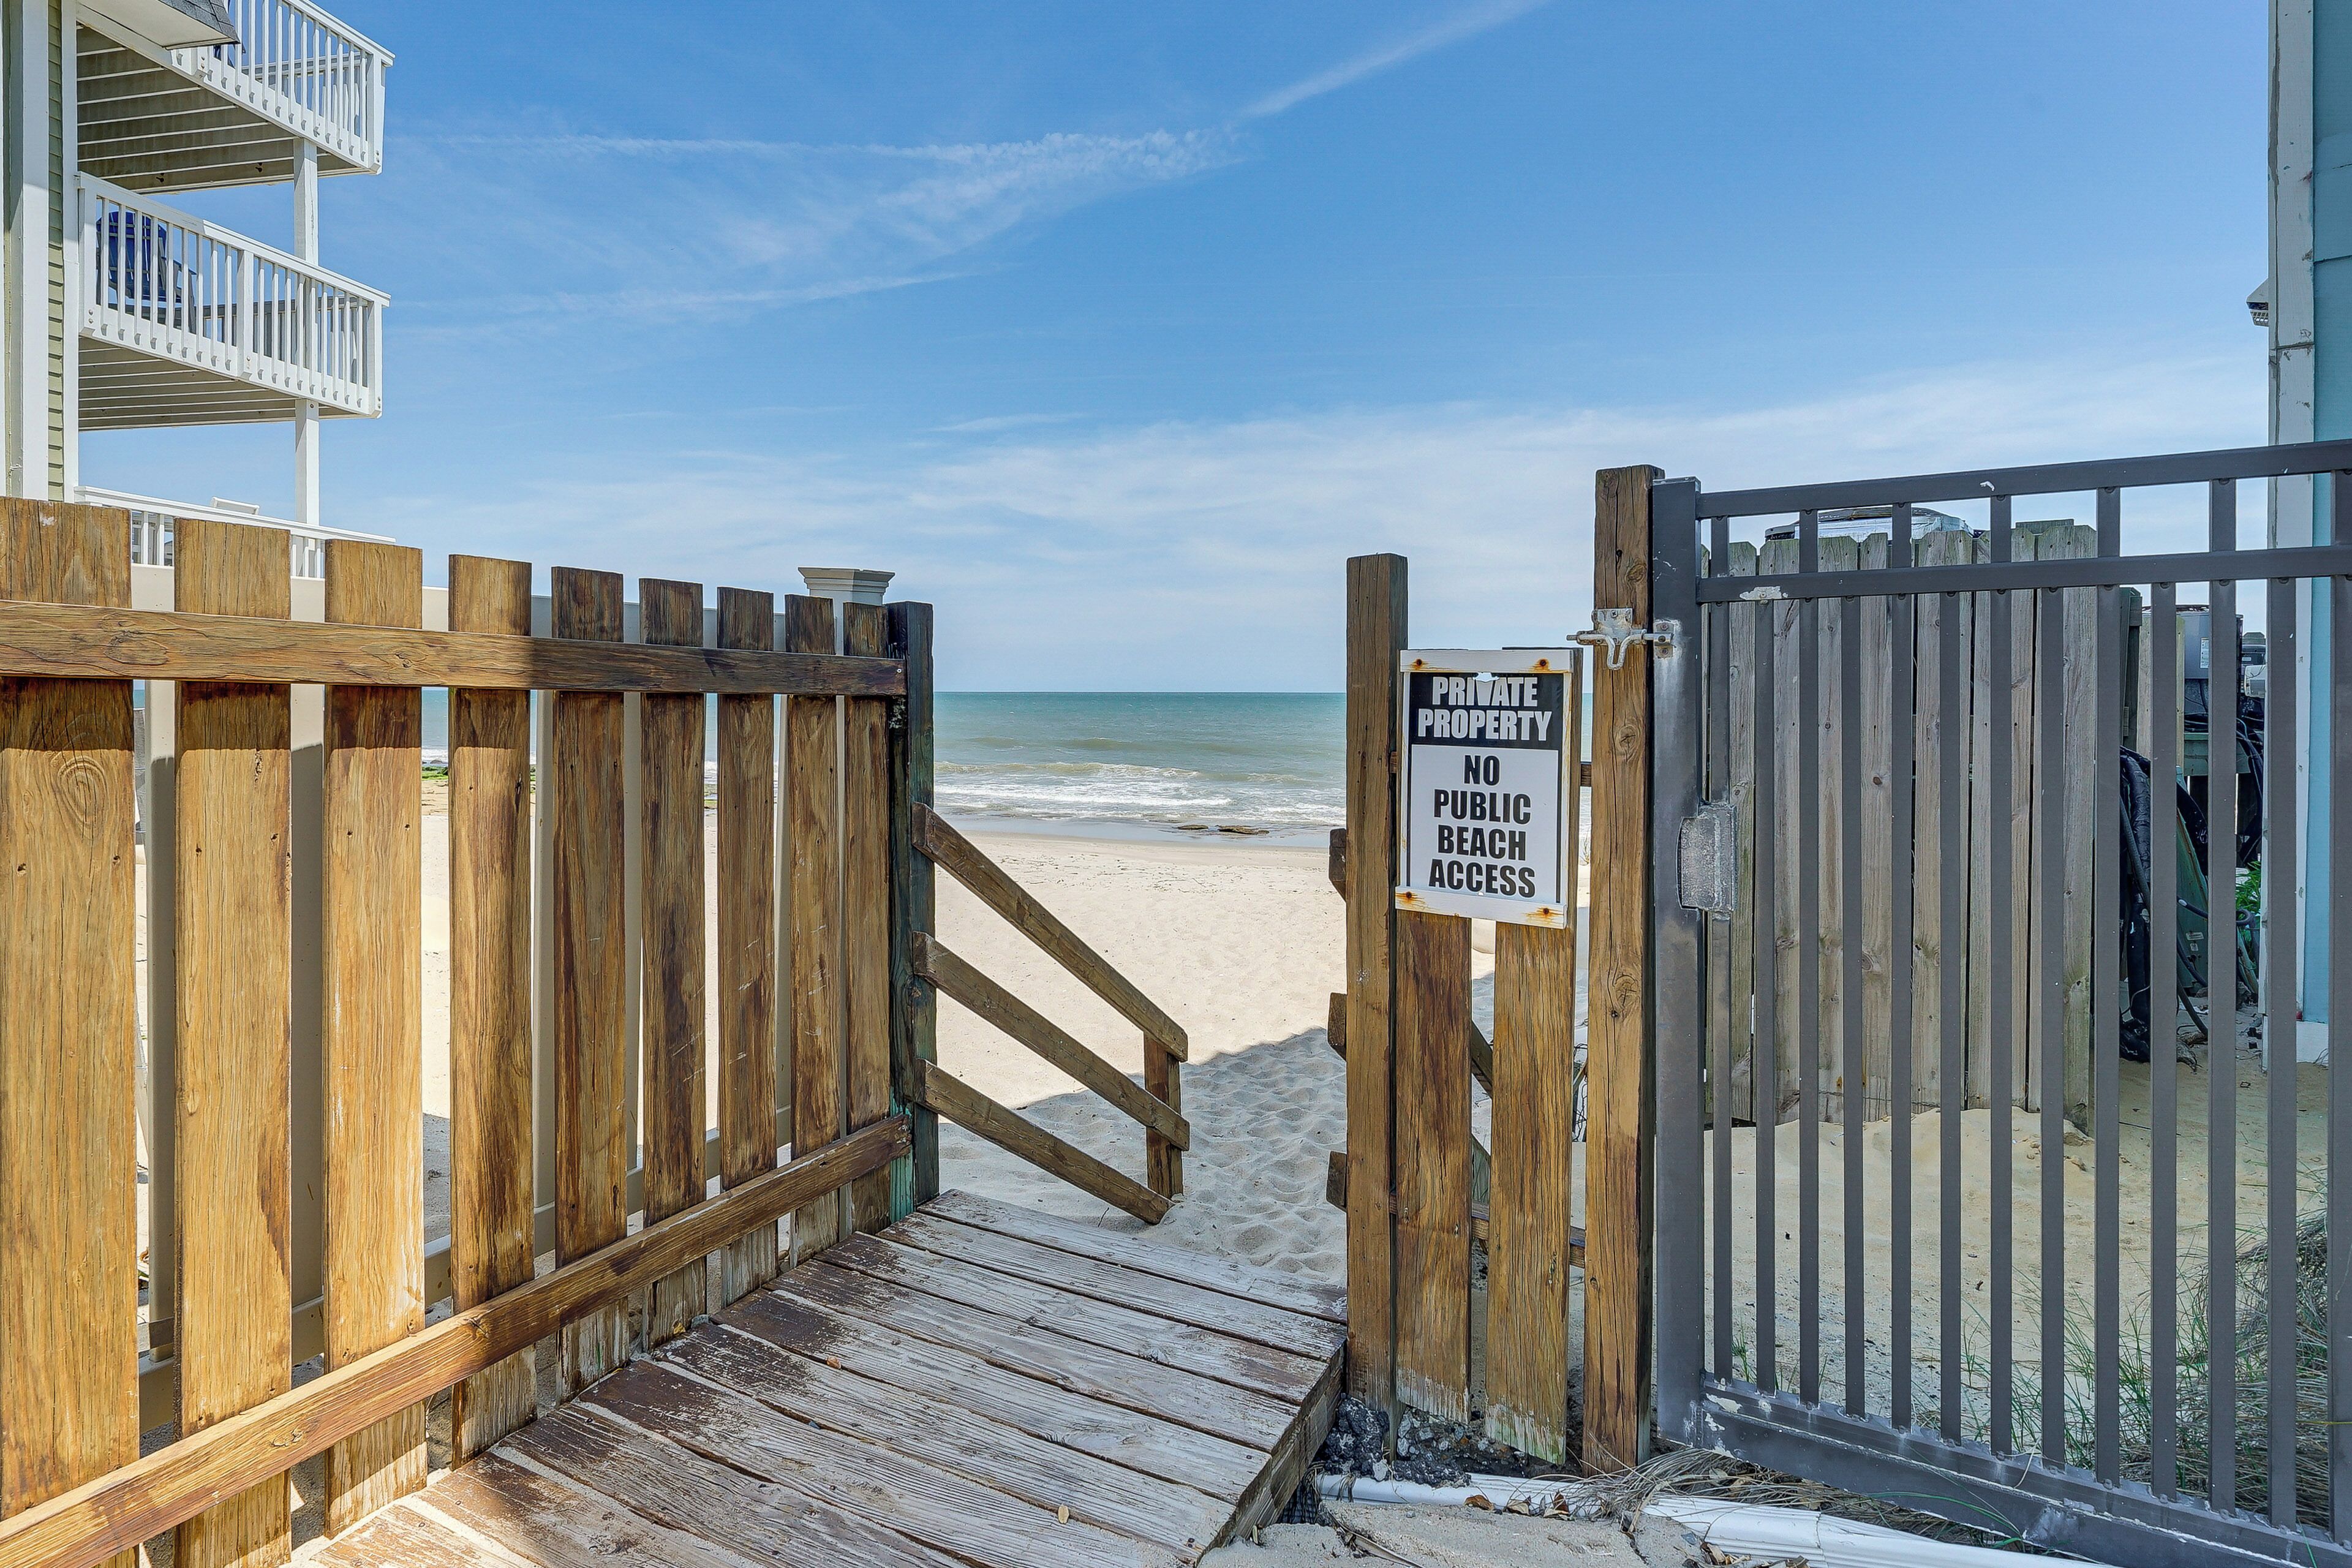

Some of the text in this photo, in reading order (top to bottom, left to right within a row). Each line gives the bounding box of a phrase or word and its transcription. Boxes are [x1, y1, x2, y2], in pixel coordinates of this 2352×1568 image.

[1432, 677, 1538, 707] PRIVATE
[1417, 709, 1553, 741] PROPERTY
[1463, 755, 1501, 786] NO
[1434, 789, 1531, 824] PUBLIC
[1438, 824, 1526, 861] BEACH
[1428, 859, 1536, 898] ACCESS
